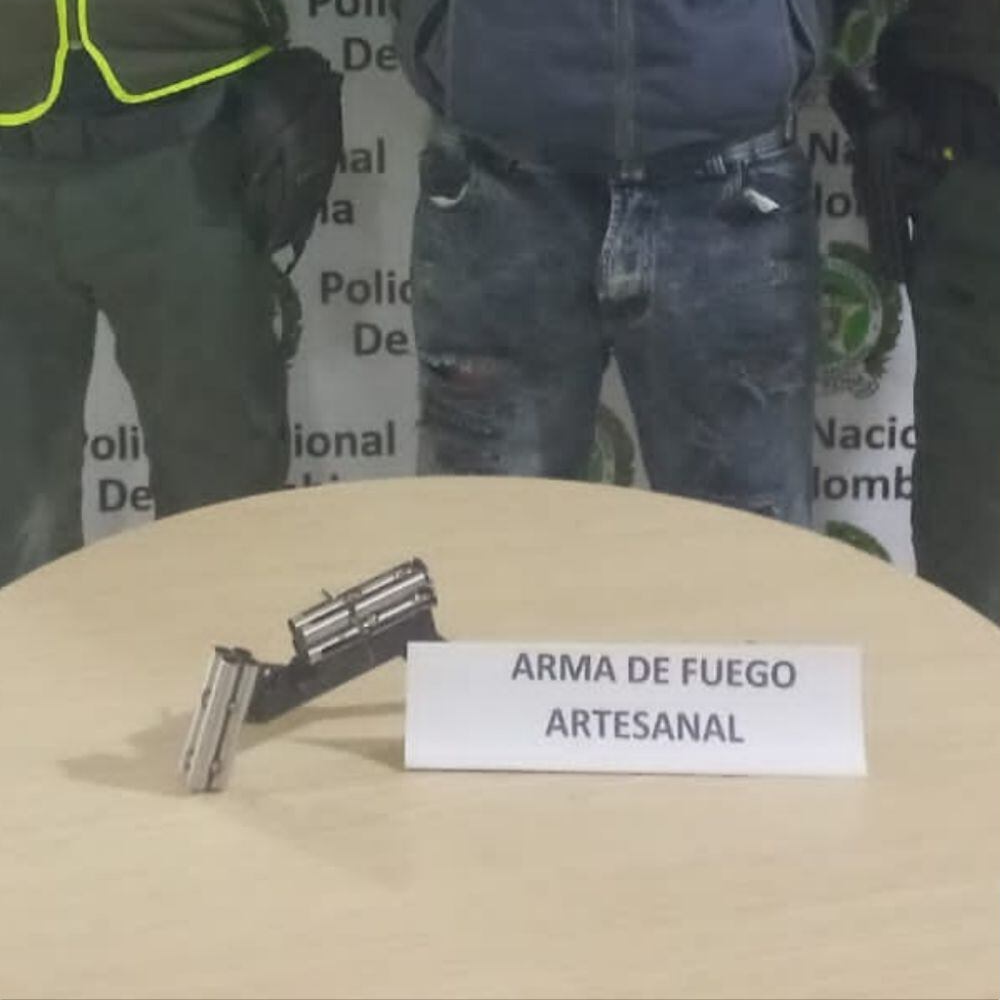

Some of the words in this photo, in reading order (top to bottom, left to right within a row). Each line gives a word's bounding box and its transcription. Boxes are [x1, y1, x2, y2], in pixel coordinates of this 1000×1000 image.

[342, 37, 398, 72] De
[353, 322, 409, 357] De
[294, 421, 396, 458] ional
[99, 477, 152, 513] De
[511, 652, 617, 683] ARMA
[627, 655, 670, 685] DE
[680, 657, 798, 689] FUEGO
[544, 707, 745, 743] ARTESANAL
